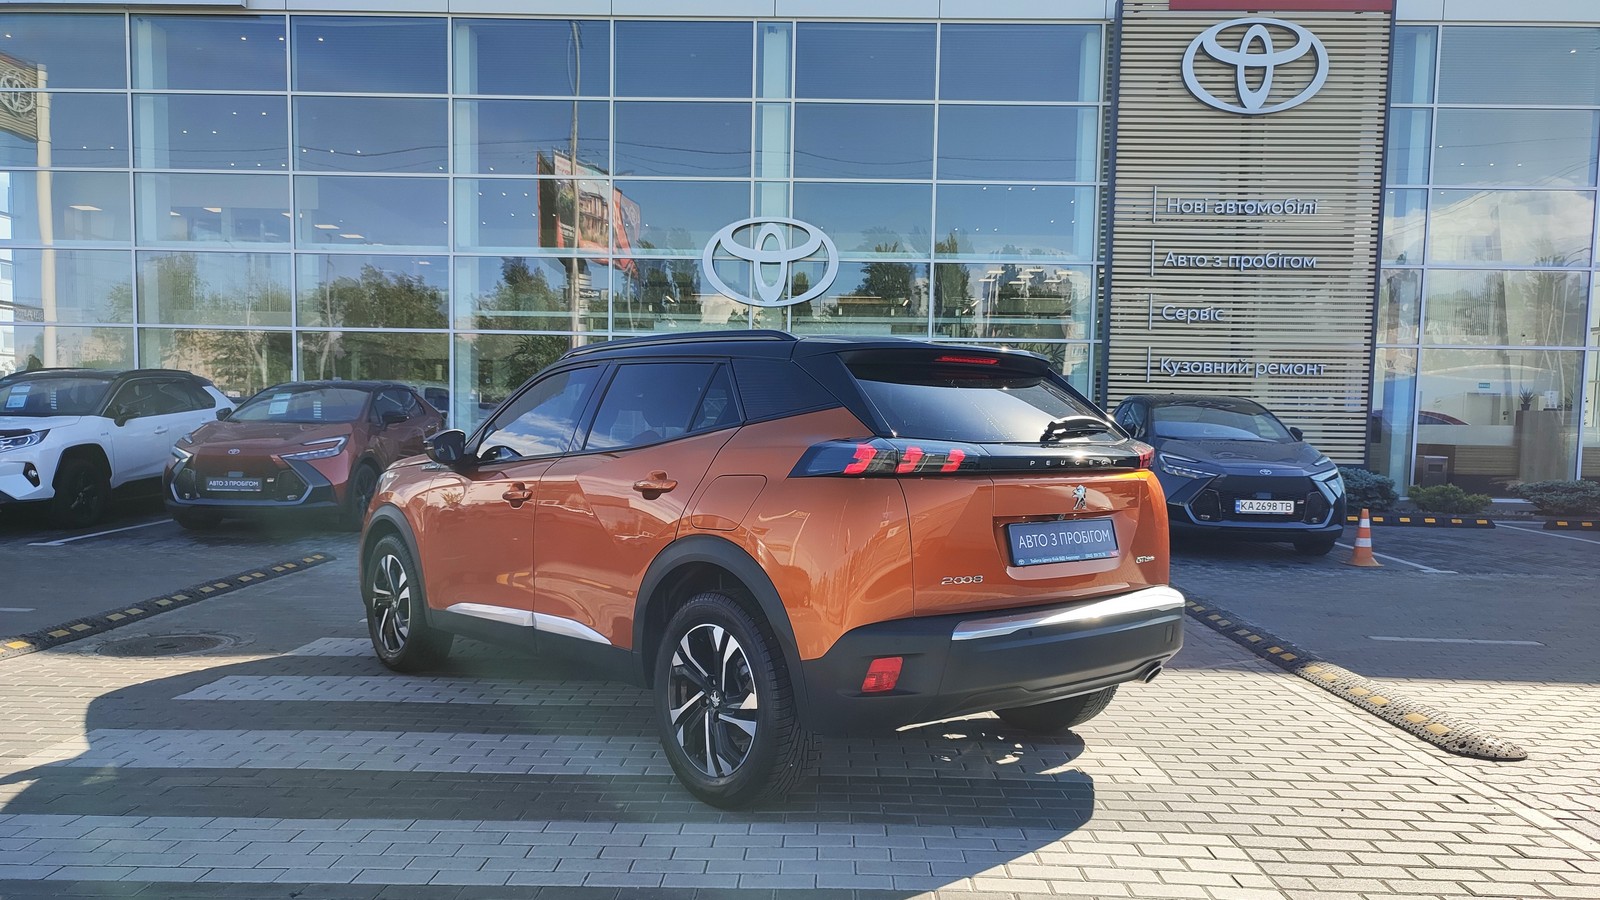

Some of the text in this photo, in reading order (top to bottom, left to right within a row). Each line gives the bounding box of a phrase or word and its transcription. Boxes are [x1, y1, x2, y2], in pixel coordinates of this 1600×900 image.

[1166, 197, 1319, 214] Нові автомобілі
[1163, 251, 1317, 271] Авто з пробігом
[1162, 304, 1226, 324] Сервіс
[1160, 357, 1327, 378] Кузовний ремонт
[1256, 502, 1278, 511] 2698
[1019, 533, 1048, 549] АВТО
[1059, 529, 1111, 545] ПРОБІГОМ
[941, 575, 984, 585] 2008
